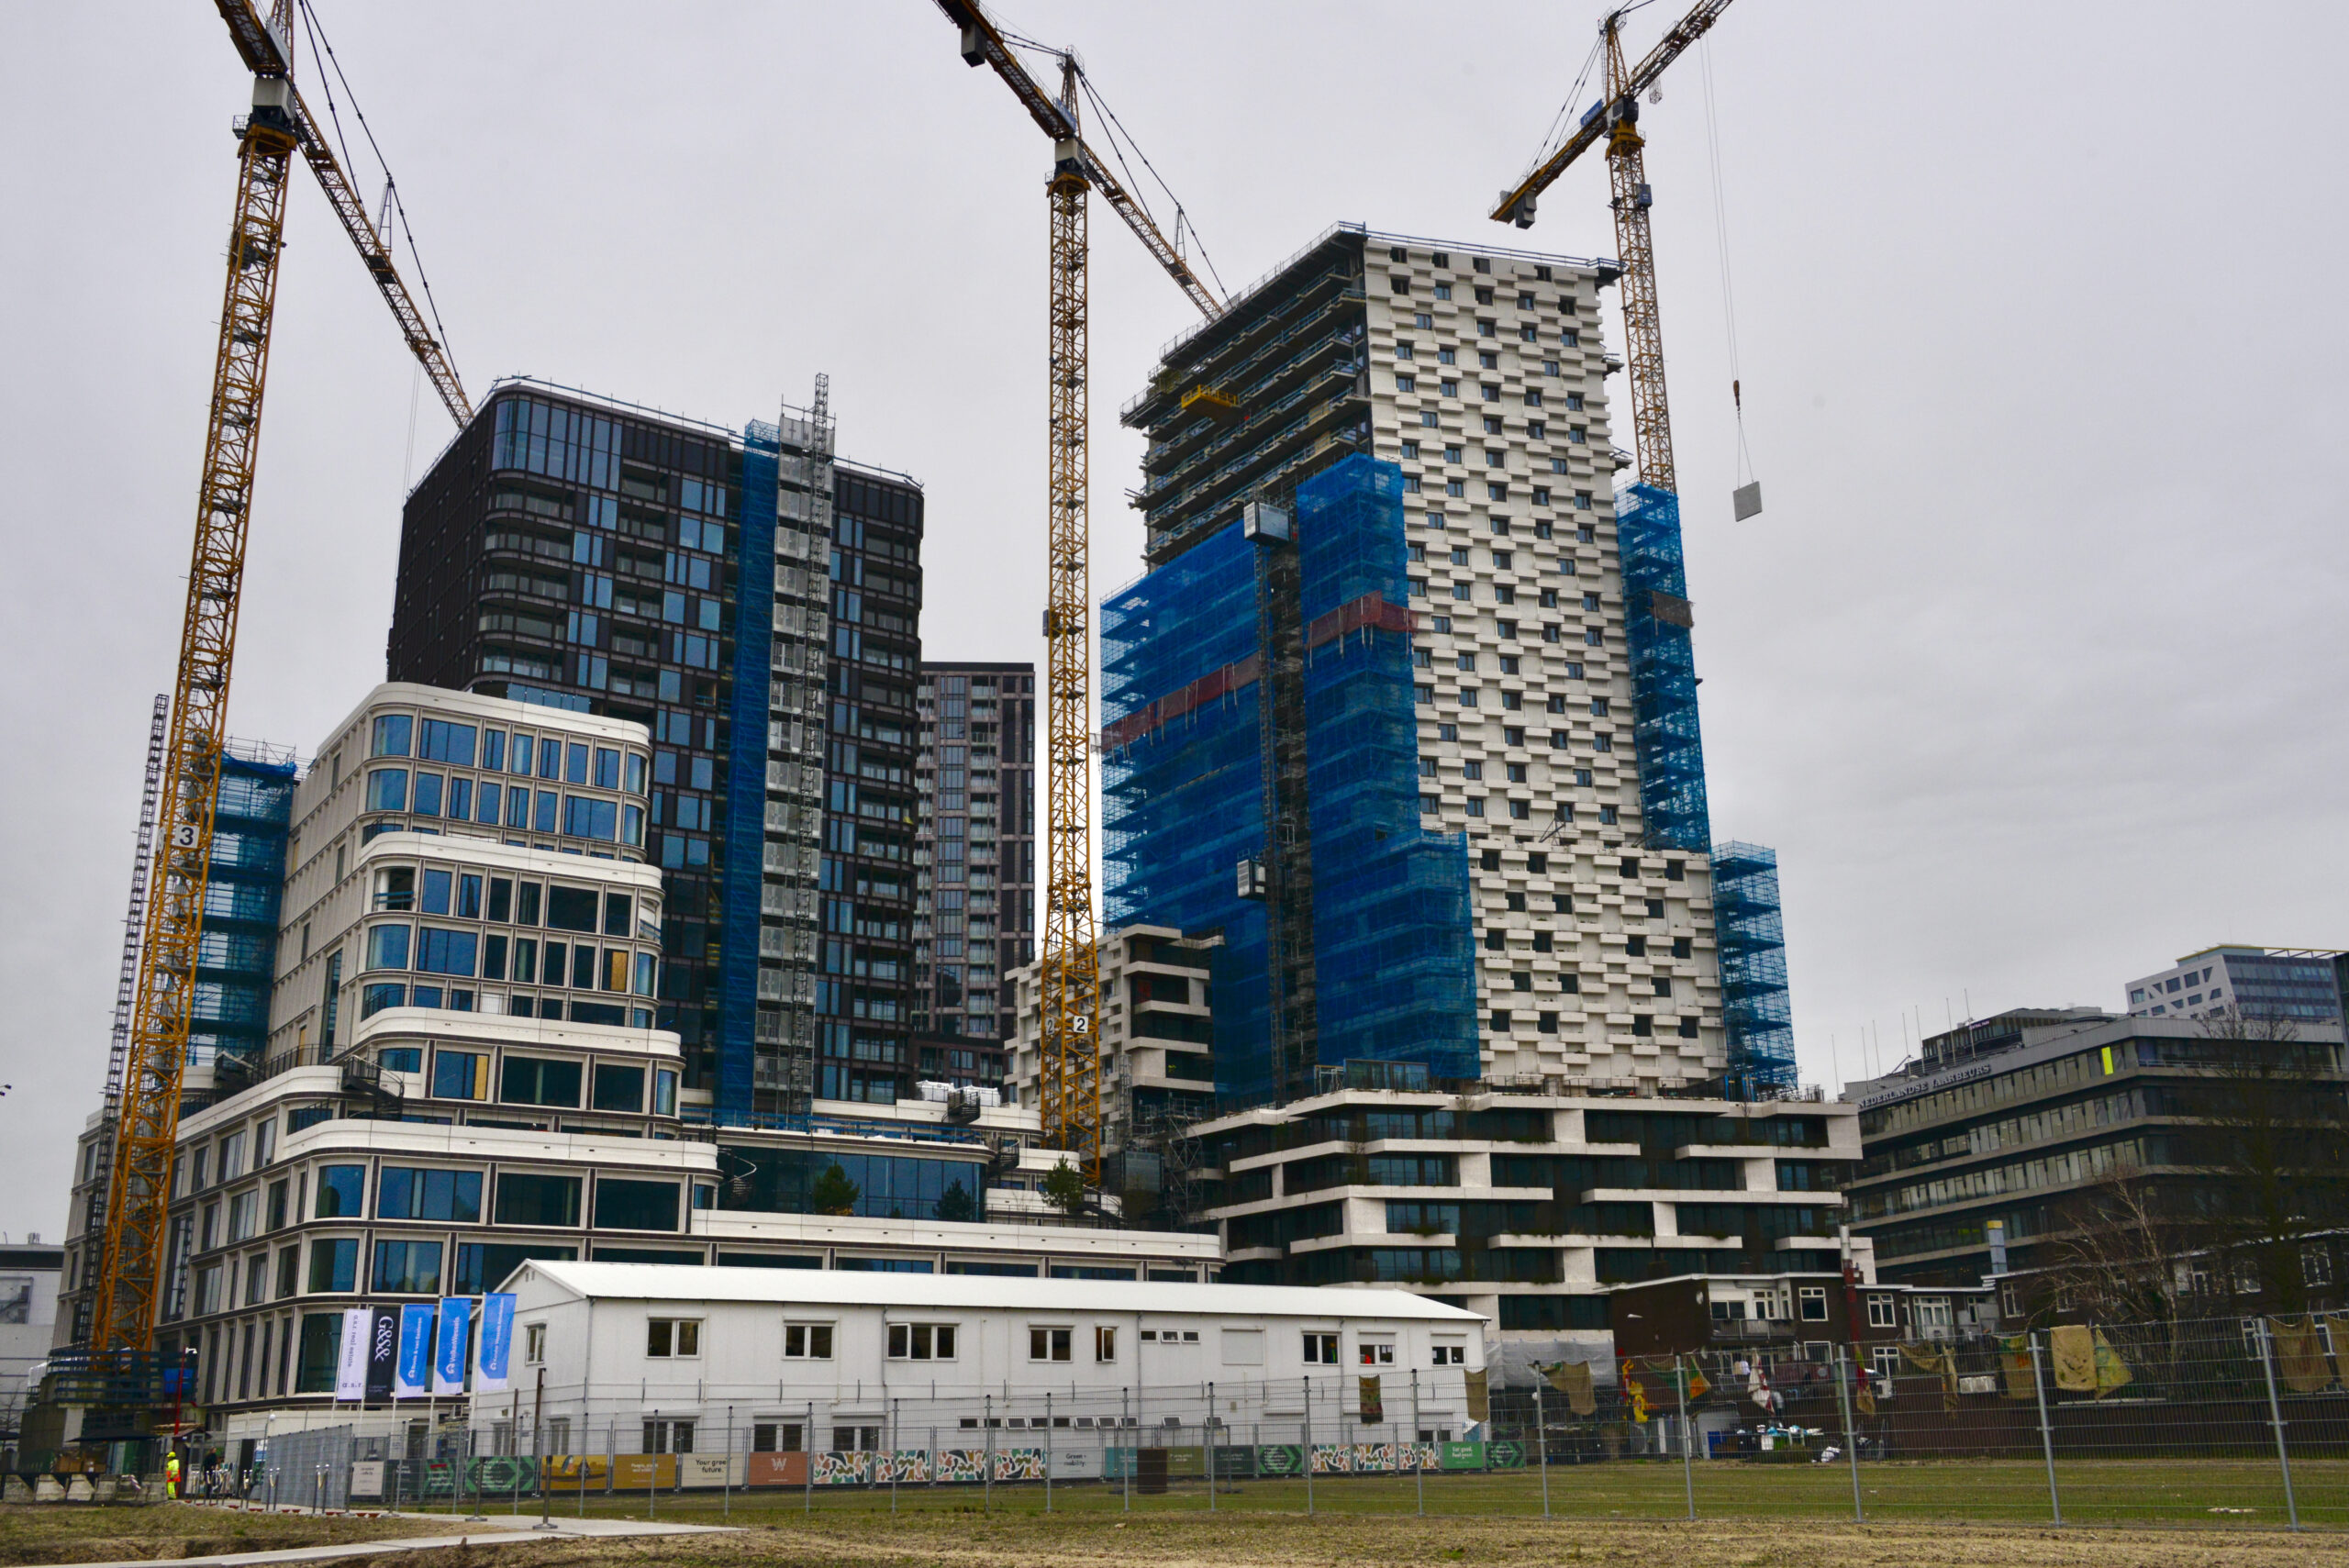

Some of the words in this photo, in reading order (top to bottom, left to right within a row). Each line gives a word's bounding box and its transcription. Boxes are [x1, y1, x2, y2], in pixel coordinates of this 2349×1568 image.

[179, 827, 195, 846] 3
[1047, 1018, 1053, 1034] 2
[1076, 1018, 1085, 1032] 2
[1858, 1083, 1929, 1108] NEDERLANDSE
